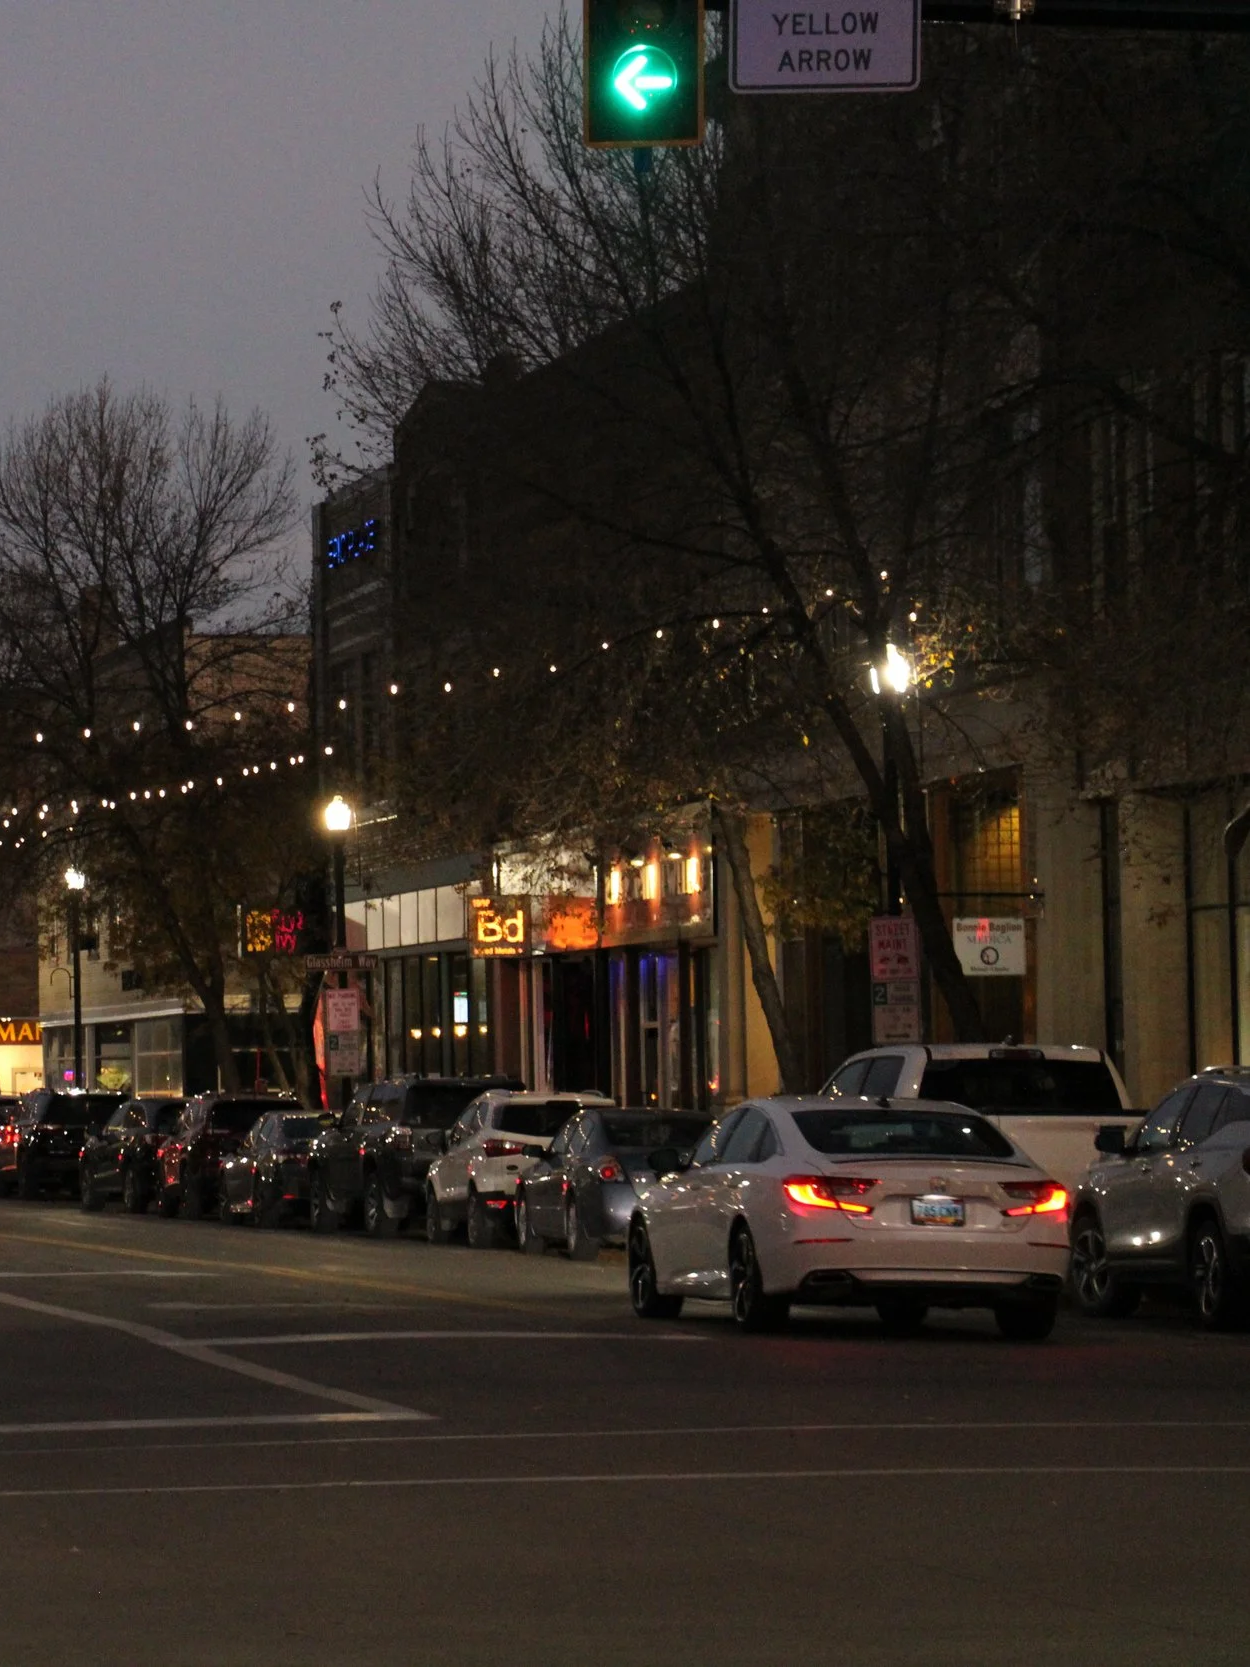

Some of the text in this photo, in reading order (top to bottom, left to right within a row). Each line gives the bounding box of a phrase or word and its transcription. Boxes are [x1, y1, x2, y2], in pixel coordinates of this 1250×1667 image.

[772, 12, 879, 36] YELLOW
[778, 48, 872, 72] ARROW
[478, 910, 524, 943] Bd
[876, 924, 910, 937] STREET
[306, 955, 377, 970] Glassheim Way
[874, 987, 886, 1003] 2
